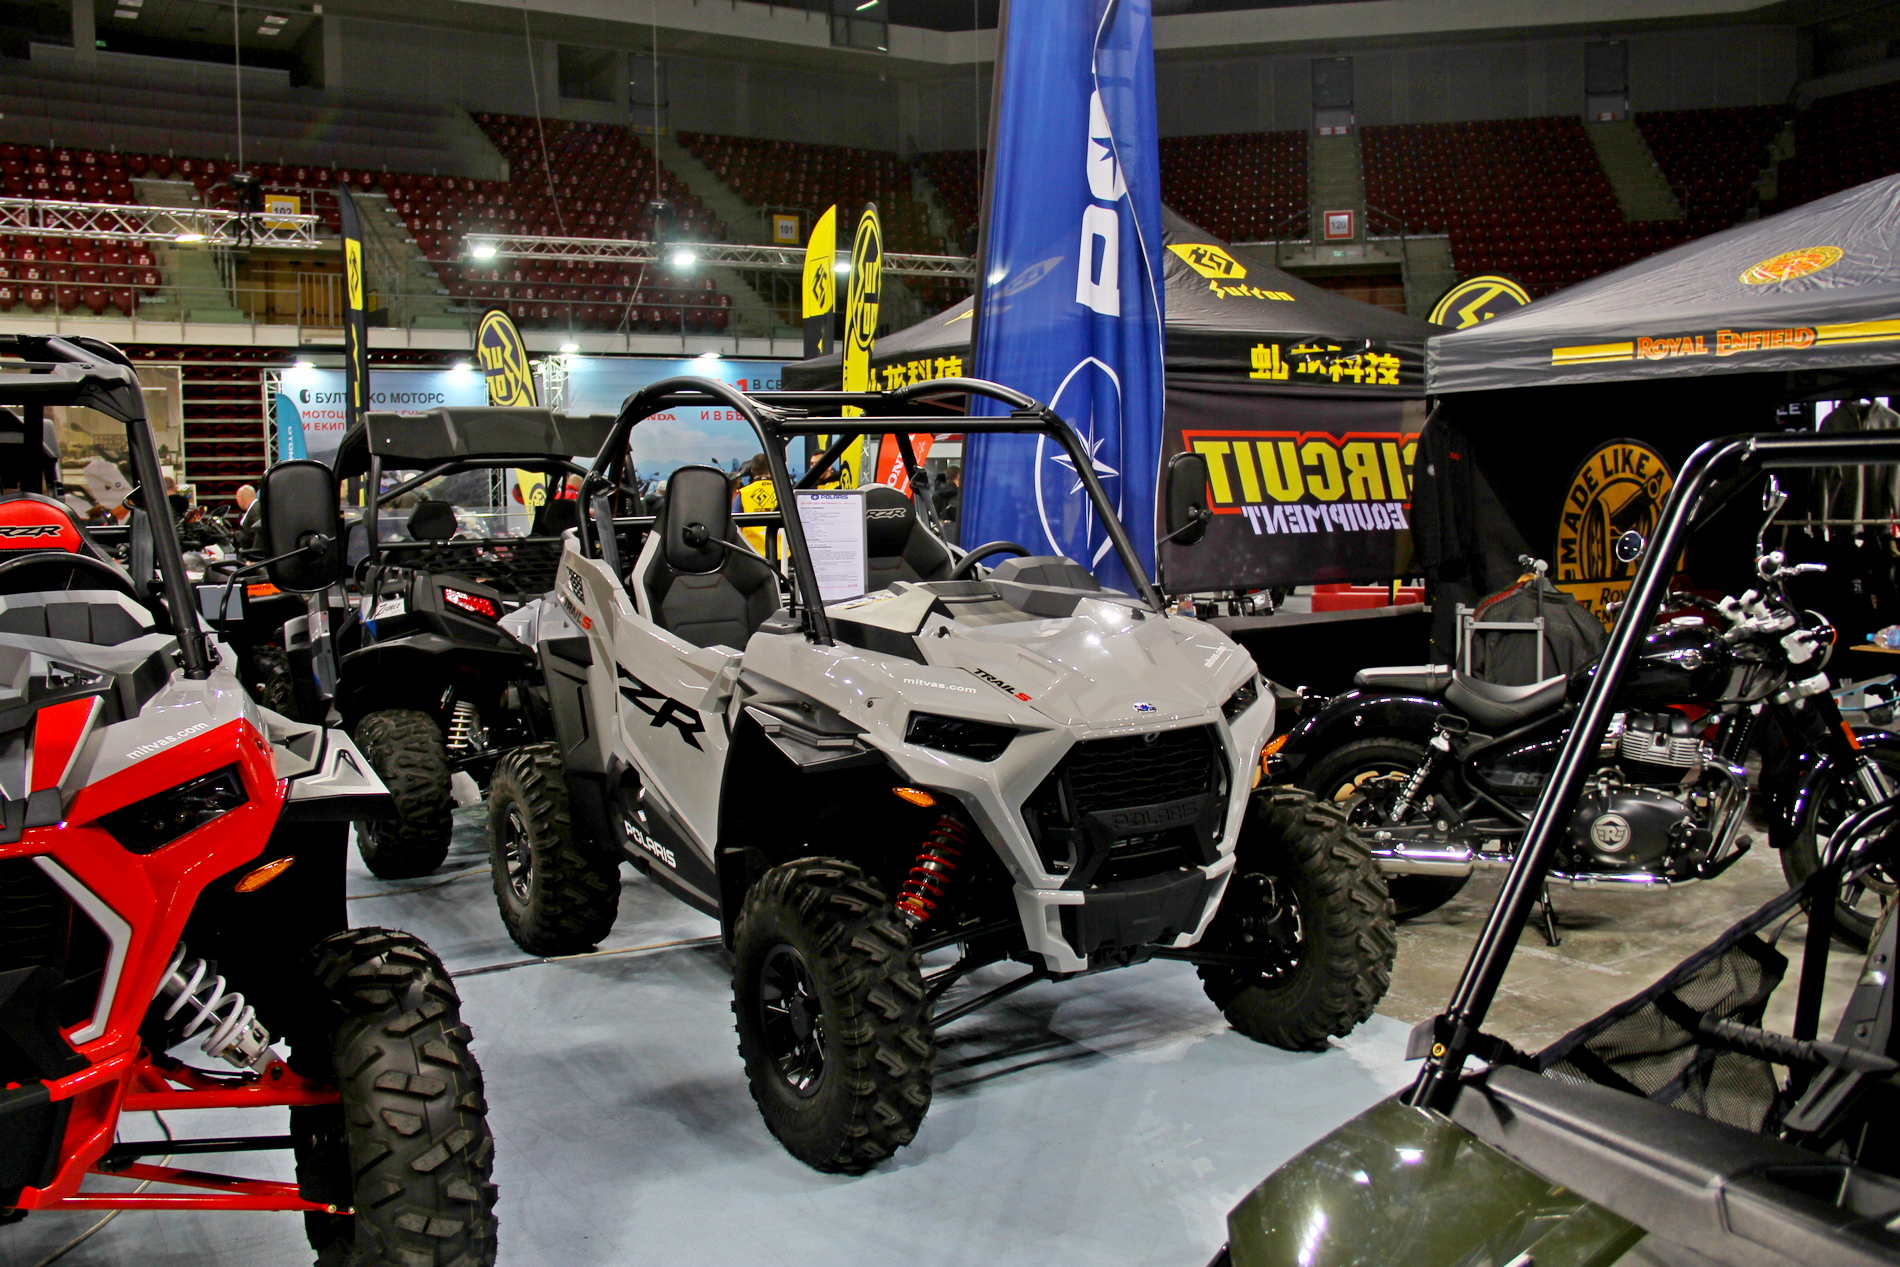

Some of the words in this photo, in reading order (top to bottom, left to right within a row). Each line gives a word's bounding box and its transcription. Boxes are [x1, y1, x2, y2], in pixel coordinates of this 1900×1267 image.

[780, 225, 793, 235] 101
[1331, 221, 1346, 230] 120
[1637, 336, 1709, 360] ROYAL
[1716, 327, 1817, 357] ENFIELD
[390, 392, 444, 404] МОТОРС
[1599, 447, 1651, 481] LIKE
[903, 677, 977, 694] mitvas.com
[126, 722, 210, 760] mitvas.com
[1111, 801, 1198, 829] POLARIS
[624, 820, 677, 868] POLARIS
